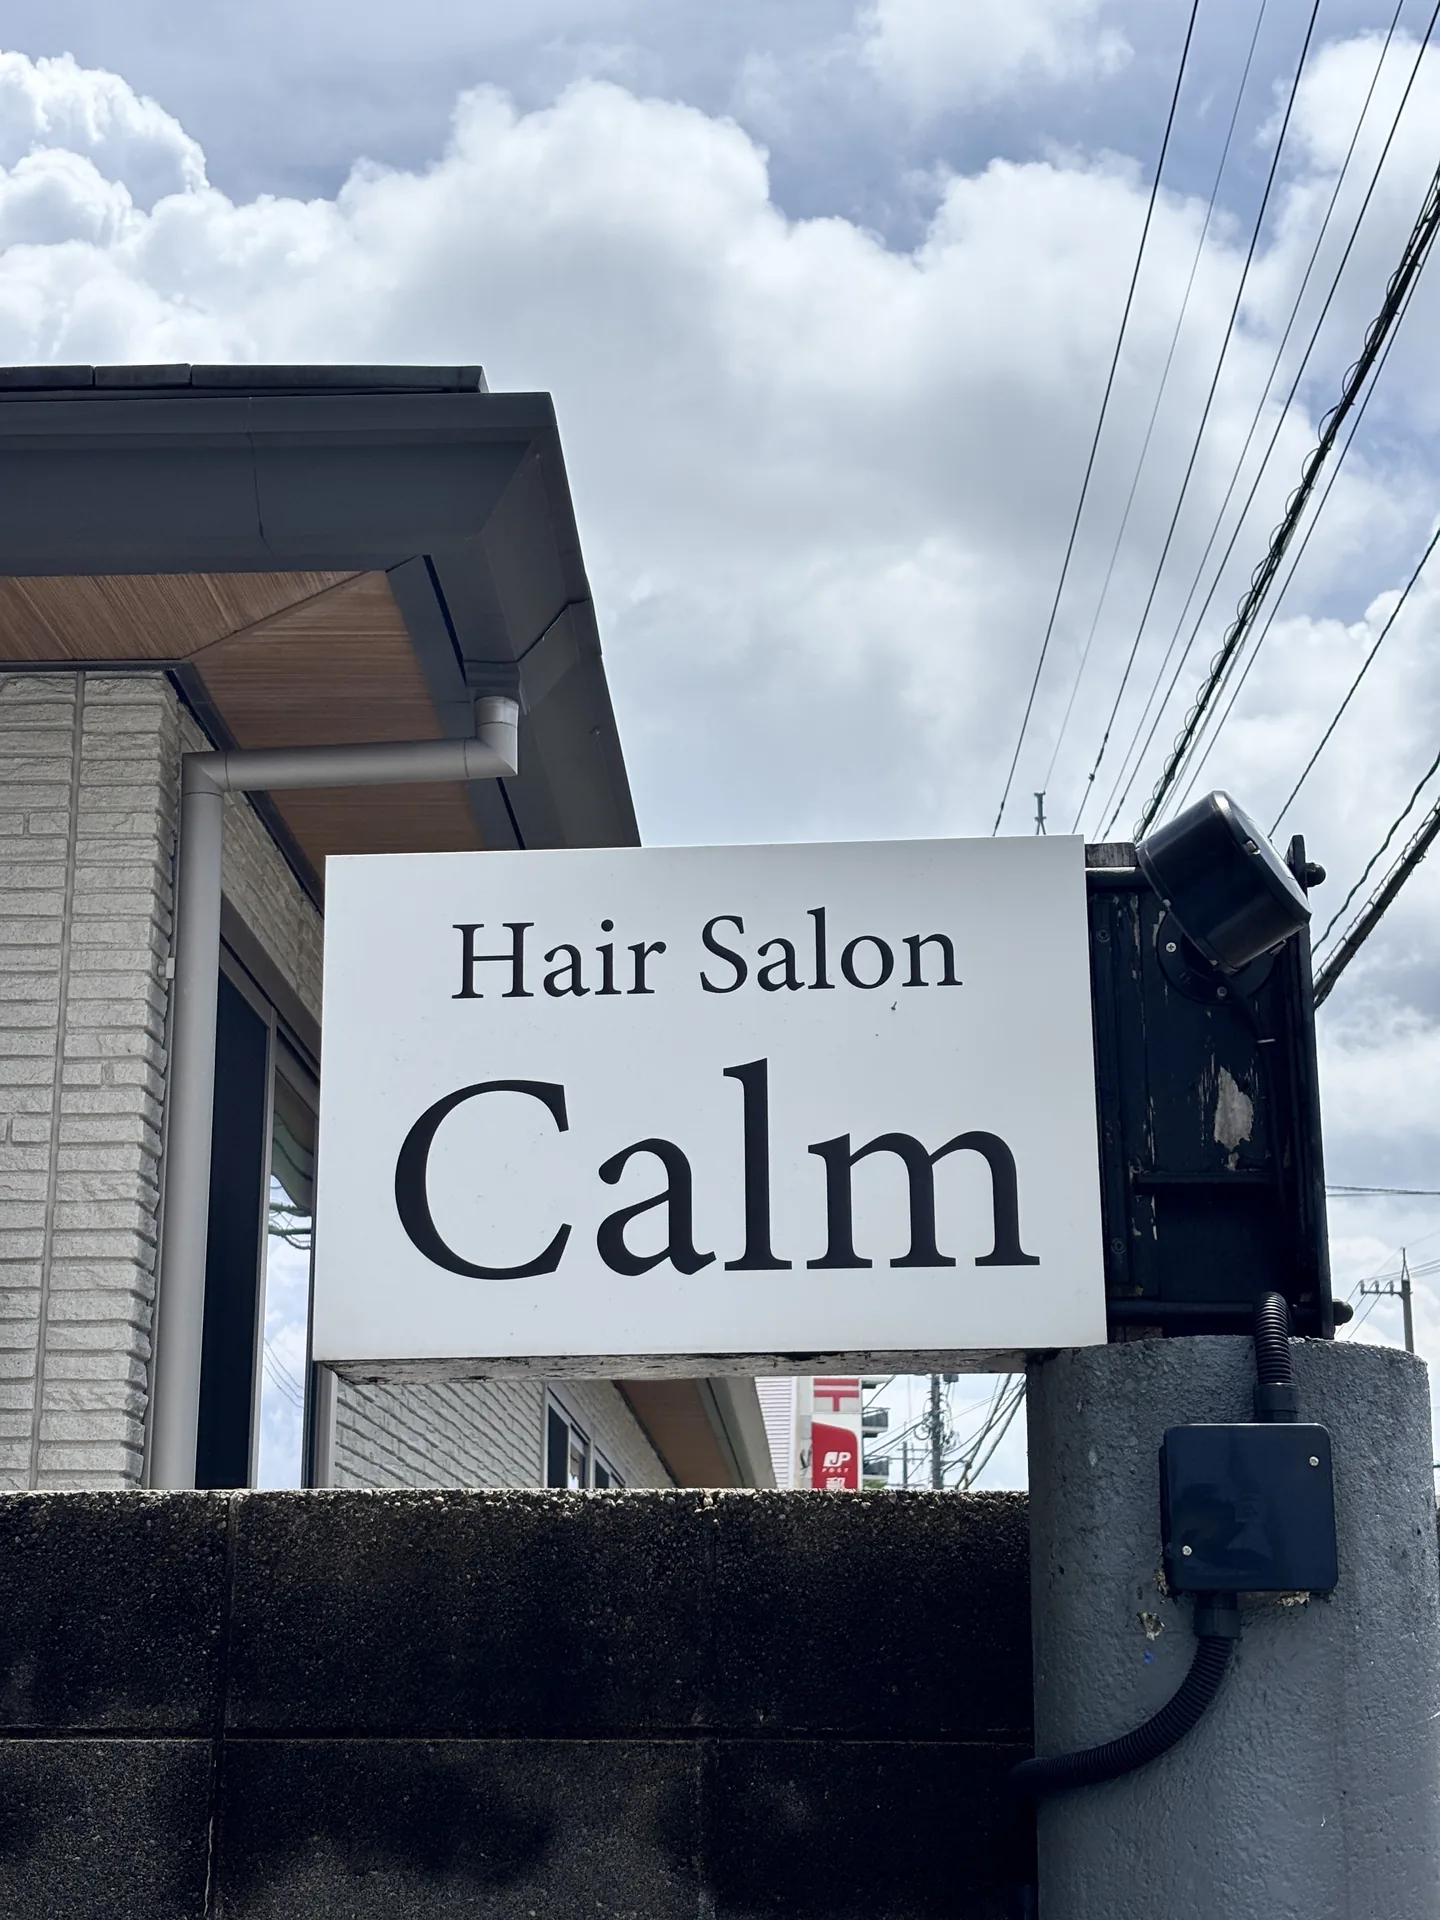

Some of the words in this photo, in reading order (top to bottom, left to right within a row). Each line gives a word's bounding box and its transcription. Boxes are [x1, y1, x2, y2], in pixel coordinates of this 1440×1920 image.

[451, 919, 667, 999] Hair
[699, 906, 963, 994] Salon
[394, 1057, 1041, 1281] Calm
